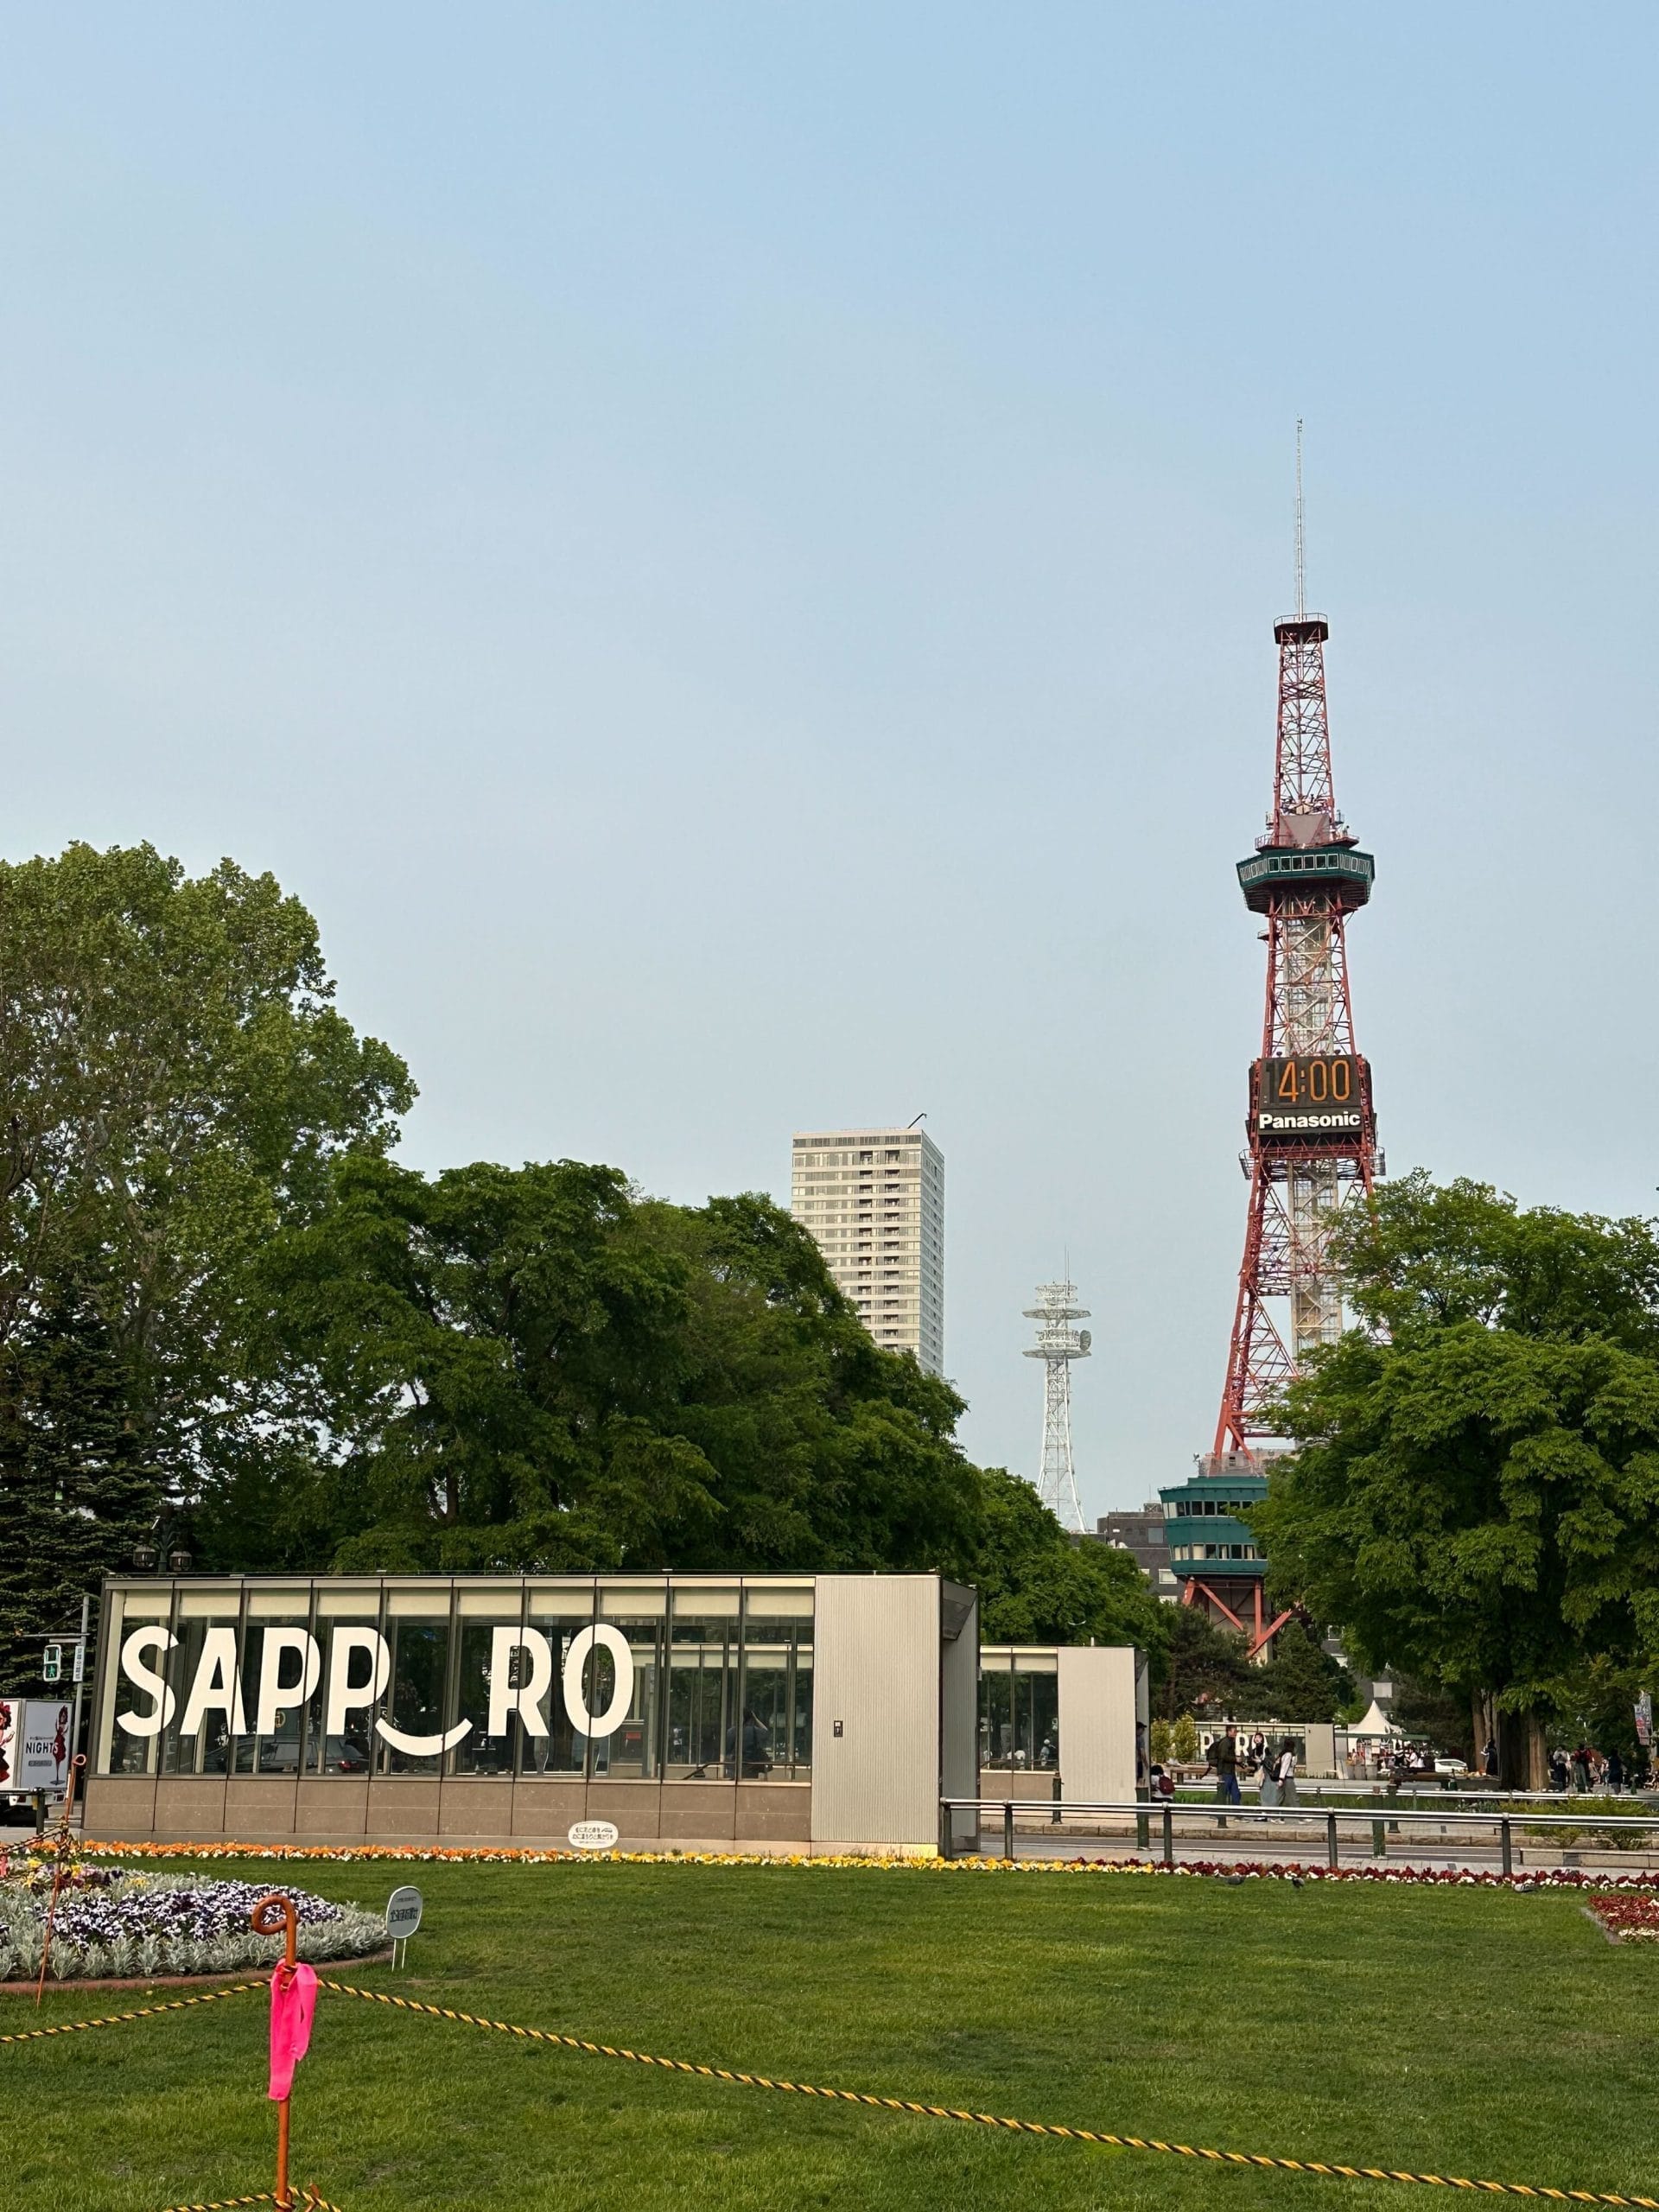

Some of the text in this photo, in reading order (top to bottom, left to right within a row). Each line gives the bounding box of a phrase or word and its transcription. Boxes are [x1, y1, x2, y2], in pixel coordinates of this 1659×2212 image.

[1278, 1059, 1351, 1103] 4:00
[1259, 1111, 1361, 1129] Panasonic
[25, 1742, 59, 1754] NIGHTS
